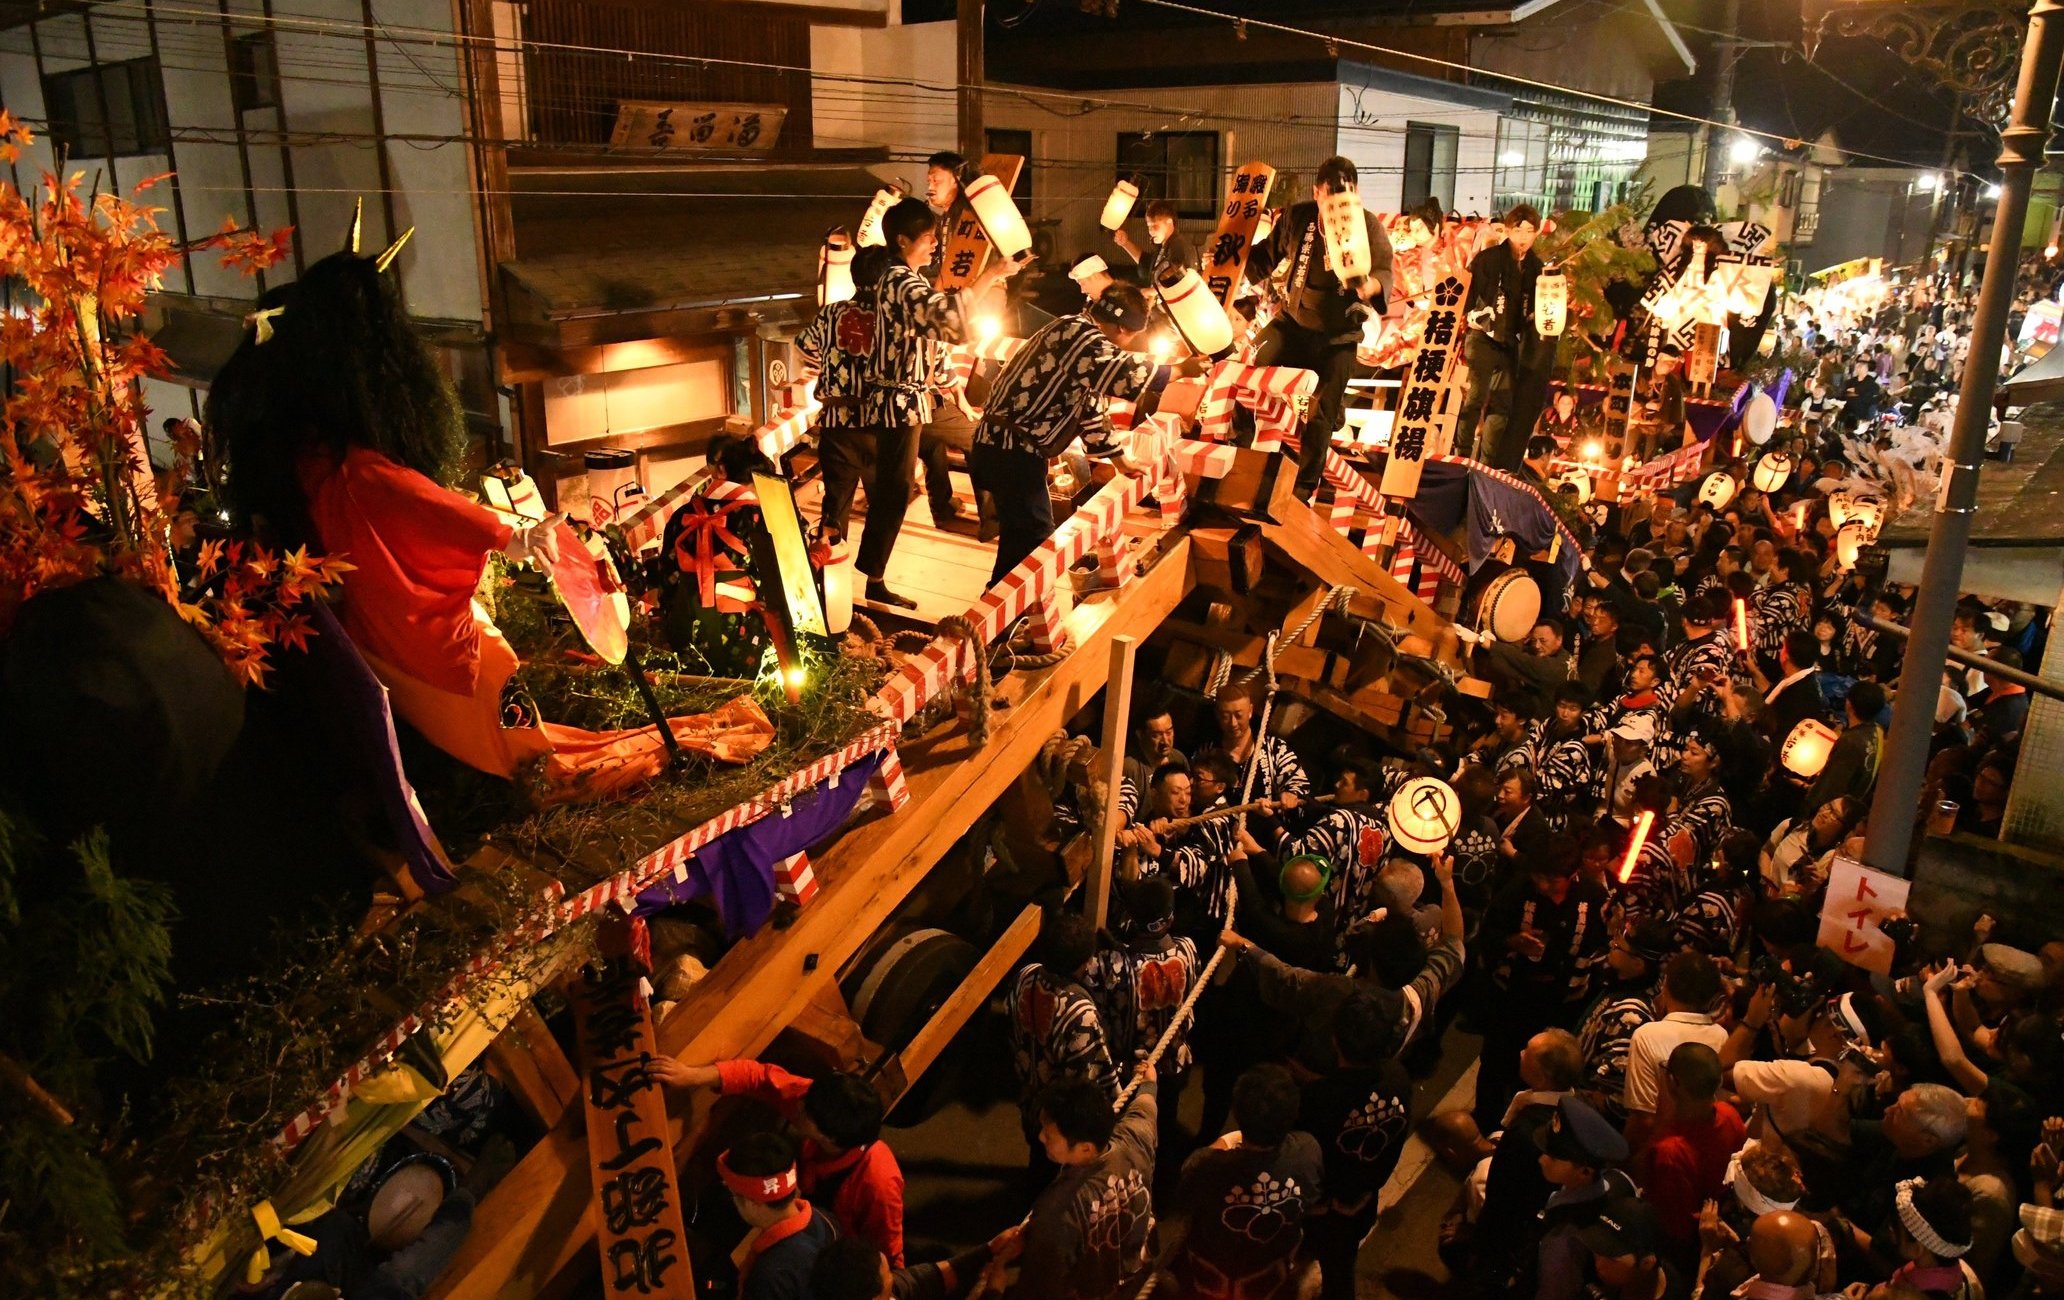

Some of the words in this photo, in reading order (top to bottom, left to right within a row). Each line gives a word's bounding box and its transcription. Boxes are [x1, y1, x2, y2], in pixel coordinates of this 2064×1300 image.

[1393, 310, 1457, 463] 桔梗旗揚
[1843, 876, 1878, 954] トイレ
